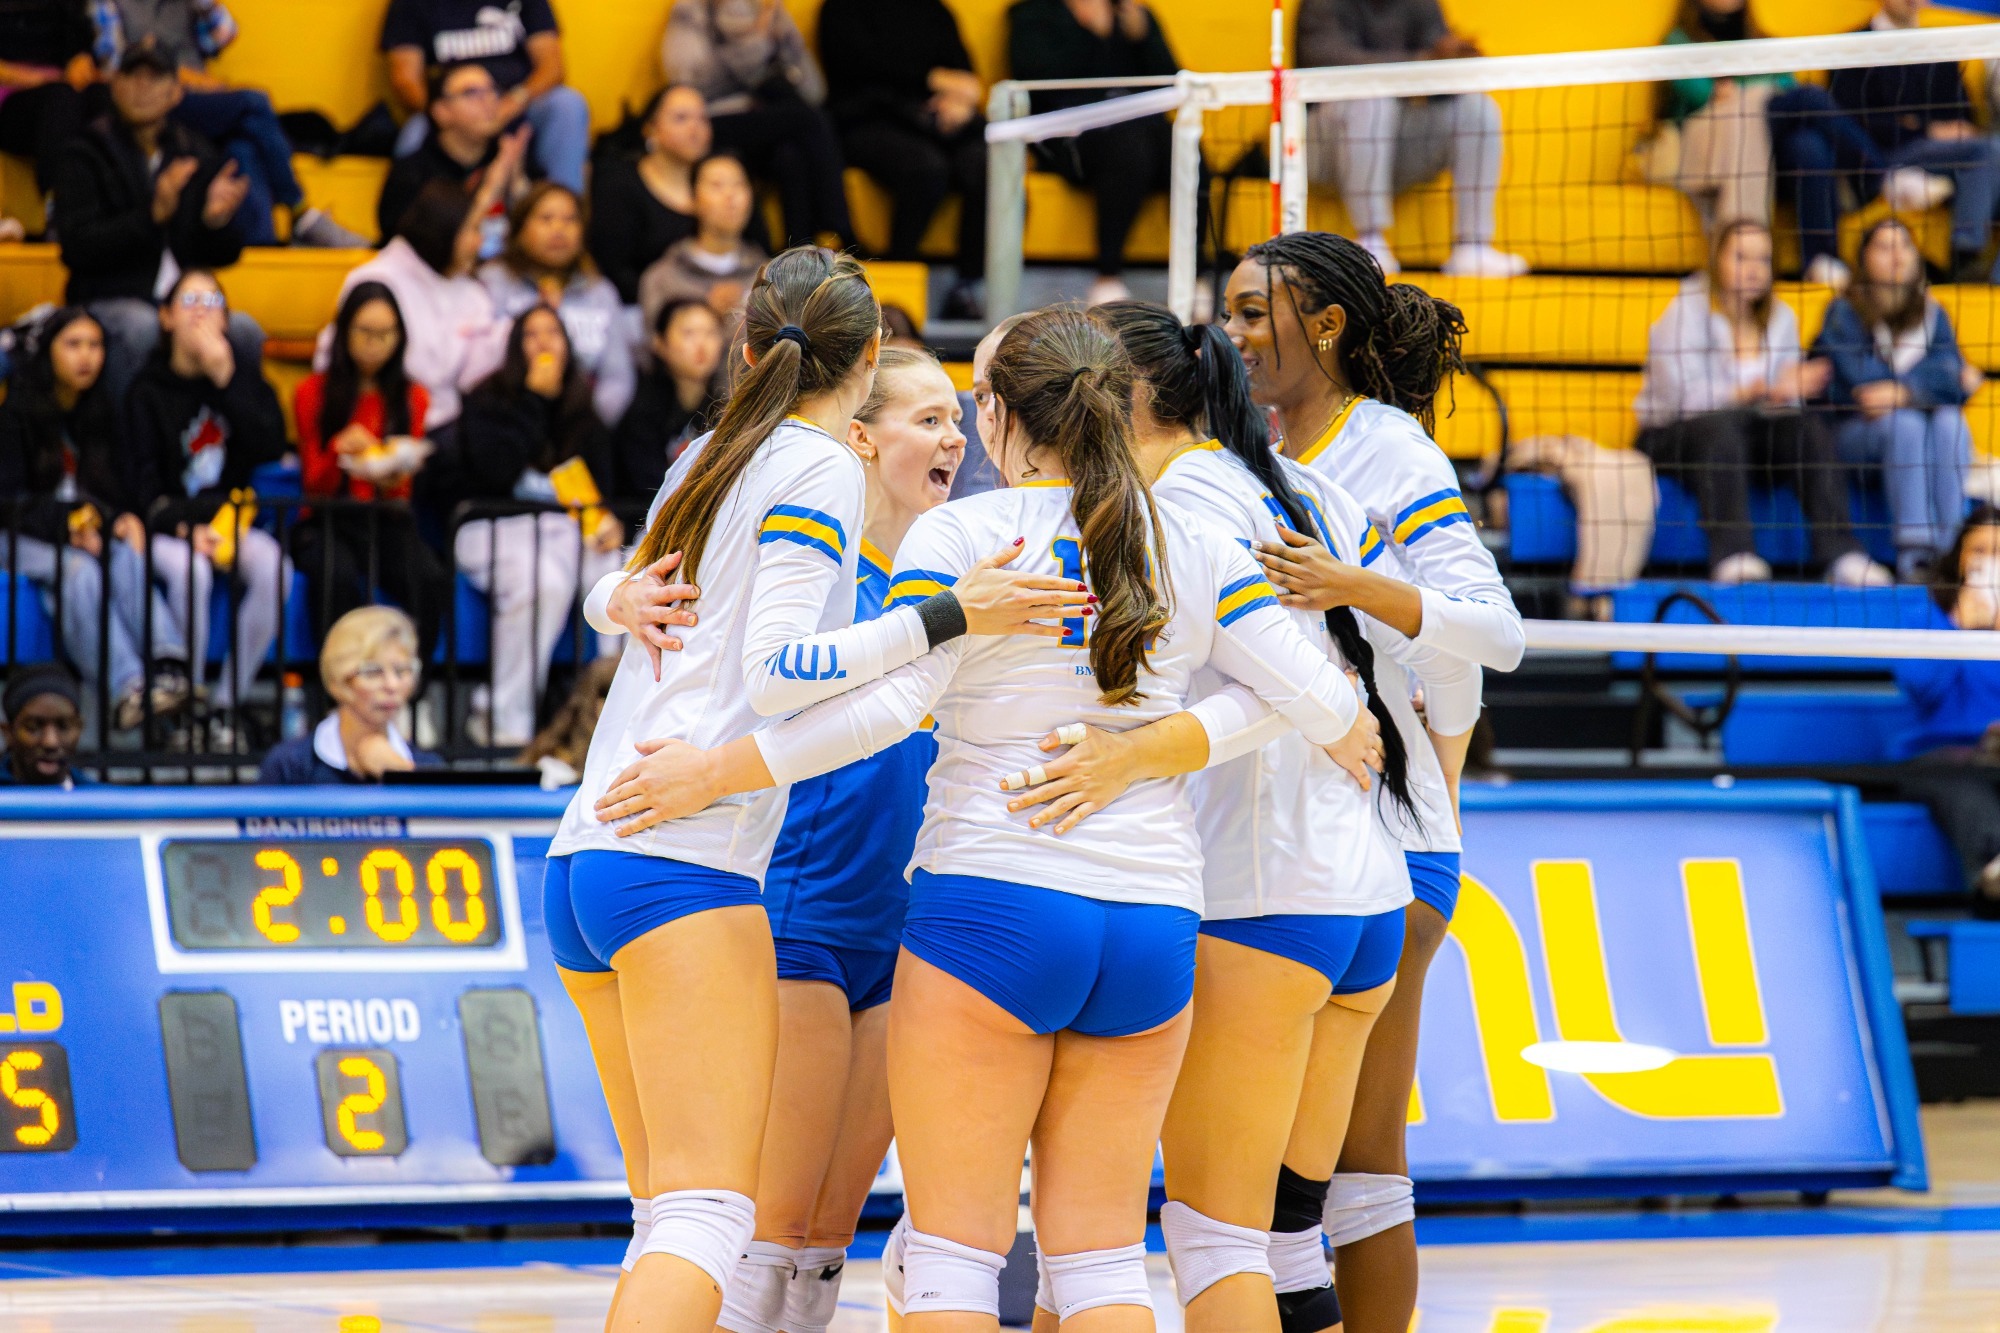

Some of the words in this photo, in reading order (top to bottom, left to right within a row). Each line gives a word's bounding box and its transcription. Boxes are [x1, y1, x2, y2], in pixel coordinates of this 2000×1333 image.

[252, 848, 488, 944] 2:00
[279, 998, 421, 1044] PERIOD
[336, 1056, 388, 1152] 2
